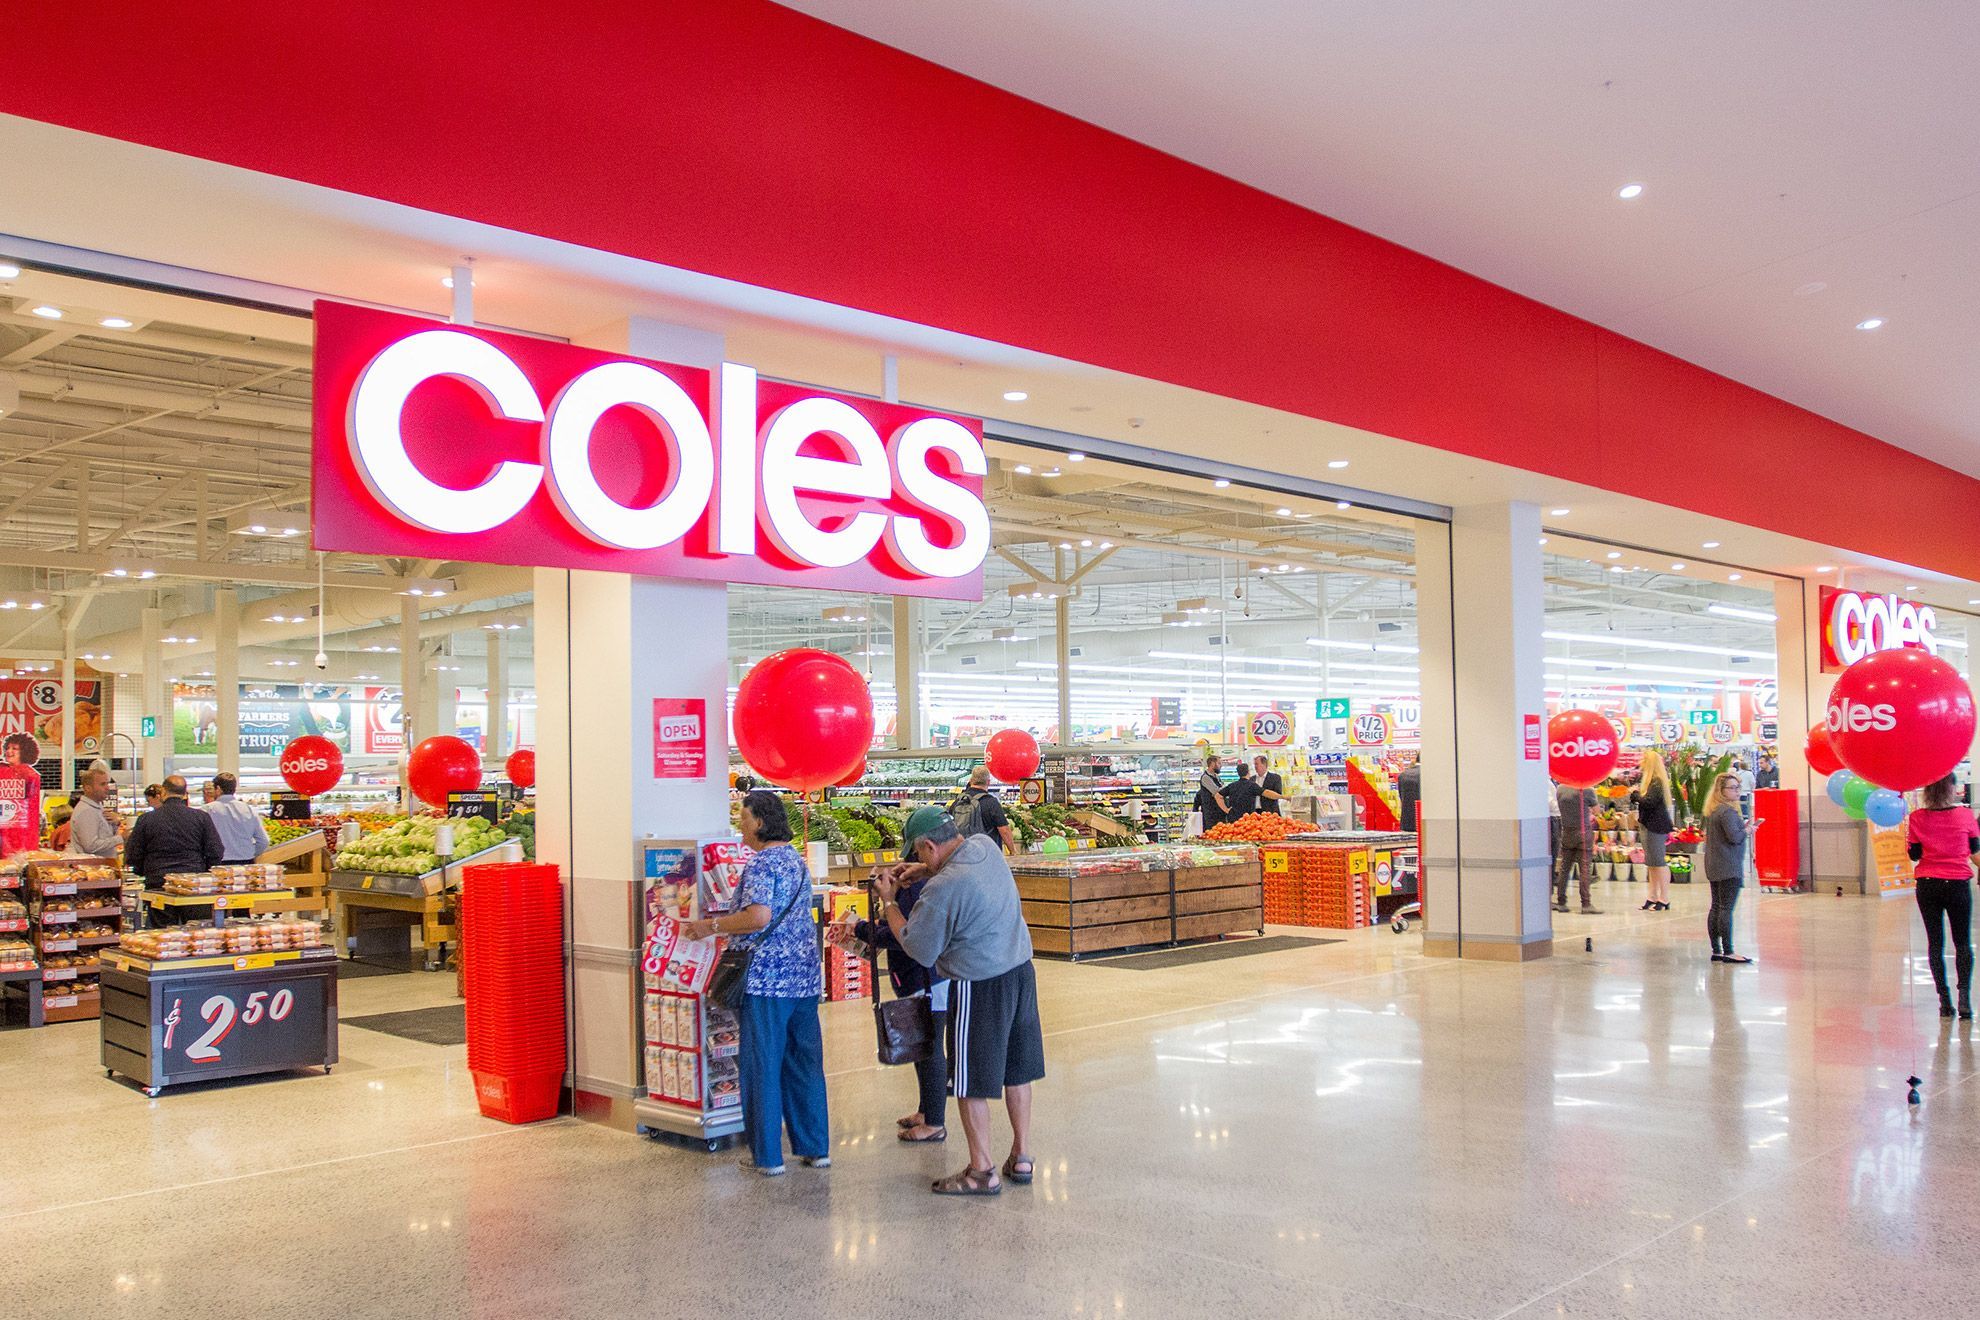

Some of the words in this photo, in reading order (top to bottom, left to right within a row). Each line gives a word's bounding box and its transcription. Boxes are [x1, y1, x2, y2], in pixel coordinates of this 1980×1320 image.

[350, 330, 991, 578] coles
[34, 686, 56, 704] $8
[238, 712, 290, 721] FARMERS
[1360, 716, 1382, 731] 1/2
[664, 724, 697, 737] OPEN
[239, 735, 289, 747] TRUST
[1550, 736, 1610, 757] coles
[281, 757, 328, 774] coles
[0, 780, 25, 789] WN
[0, 789, 25, 798] WN
